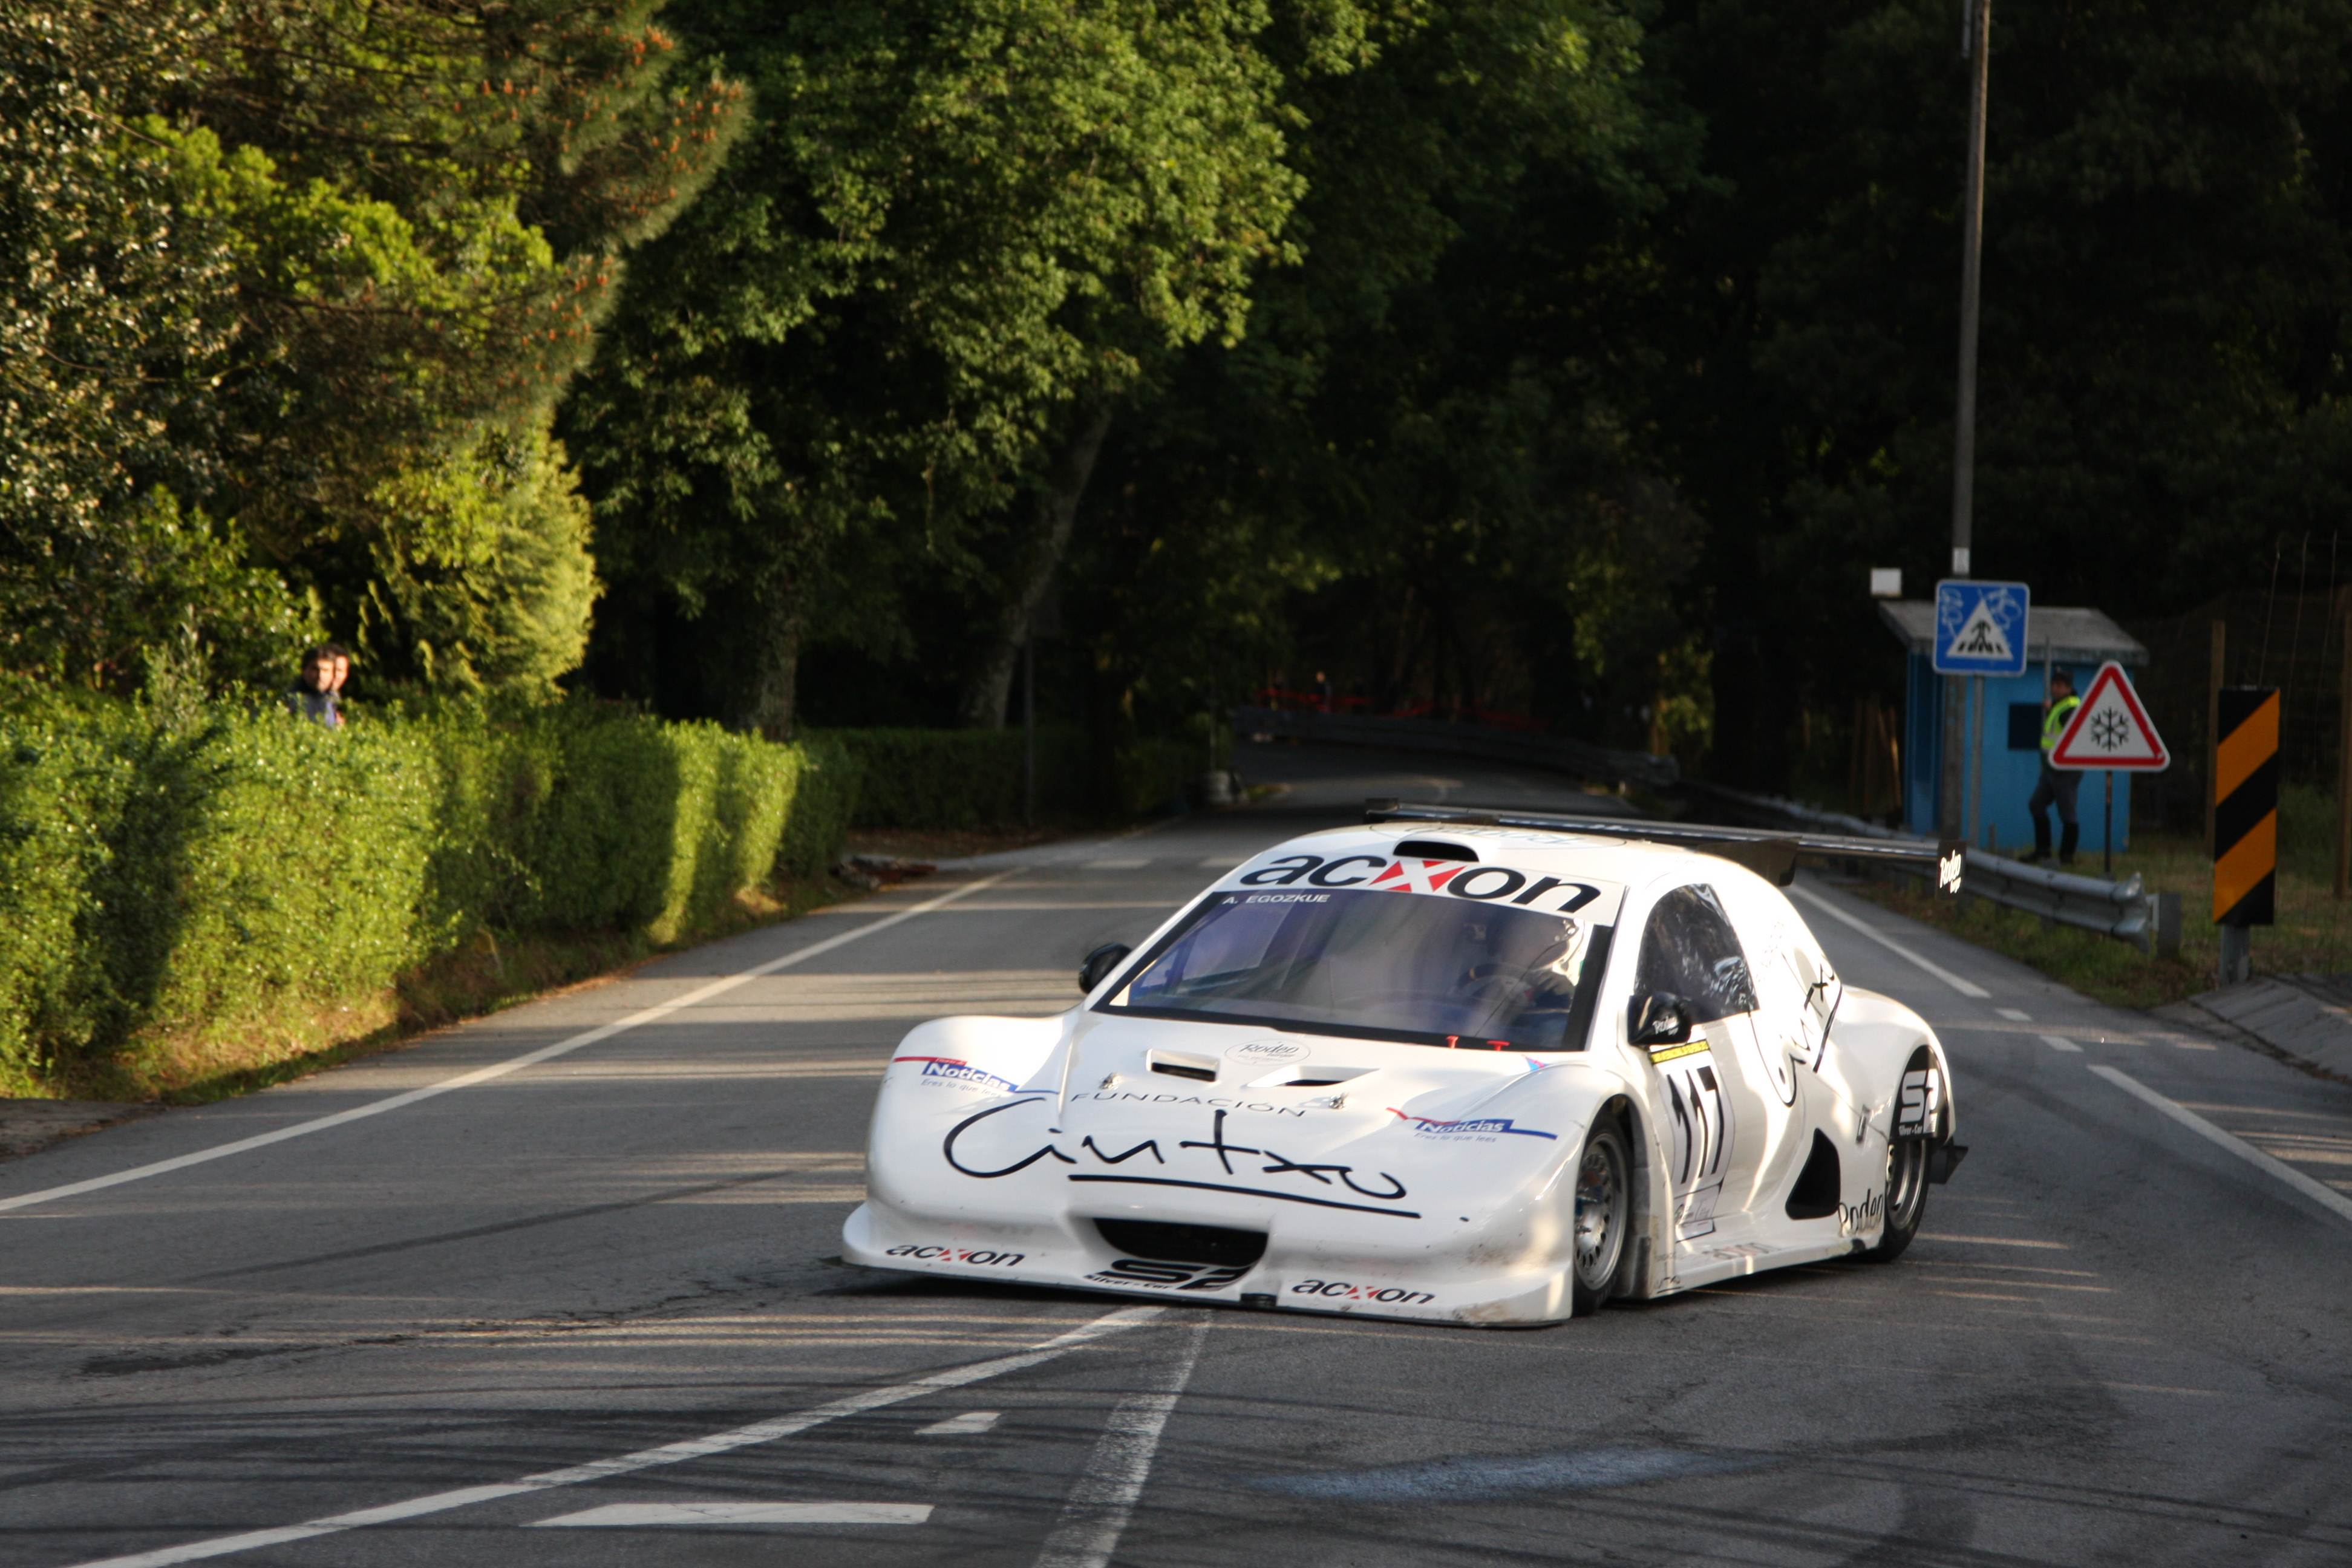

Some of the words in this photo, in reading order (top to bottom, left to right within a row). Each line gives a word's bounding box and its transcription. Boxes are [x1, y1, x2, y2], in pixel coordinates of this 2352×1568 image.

[1245, 894, 1331, 904] EGOZKUE
[926, 1062, 1010, 1091] Noticias
[959, 1084, 979, 1093] que
[1071, 1092, 1305, 1117] FUNDACIÓN
[1422, 1120, 1505, 1133] Noticias
[1666, 1065, 1725, 1184] 117
